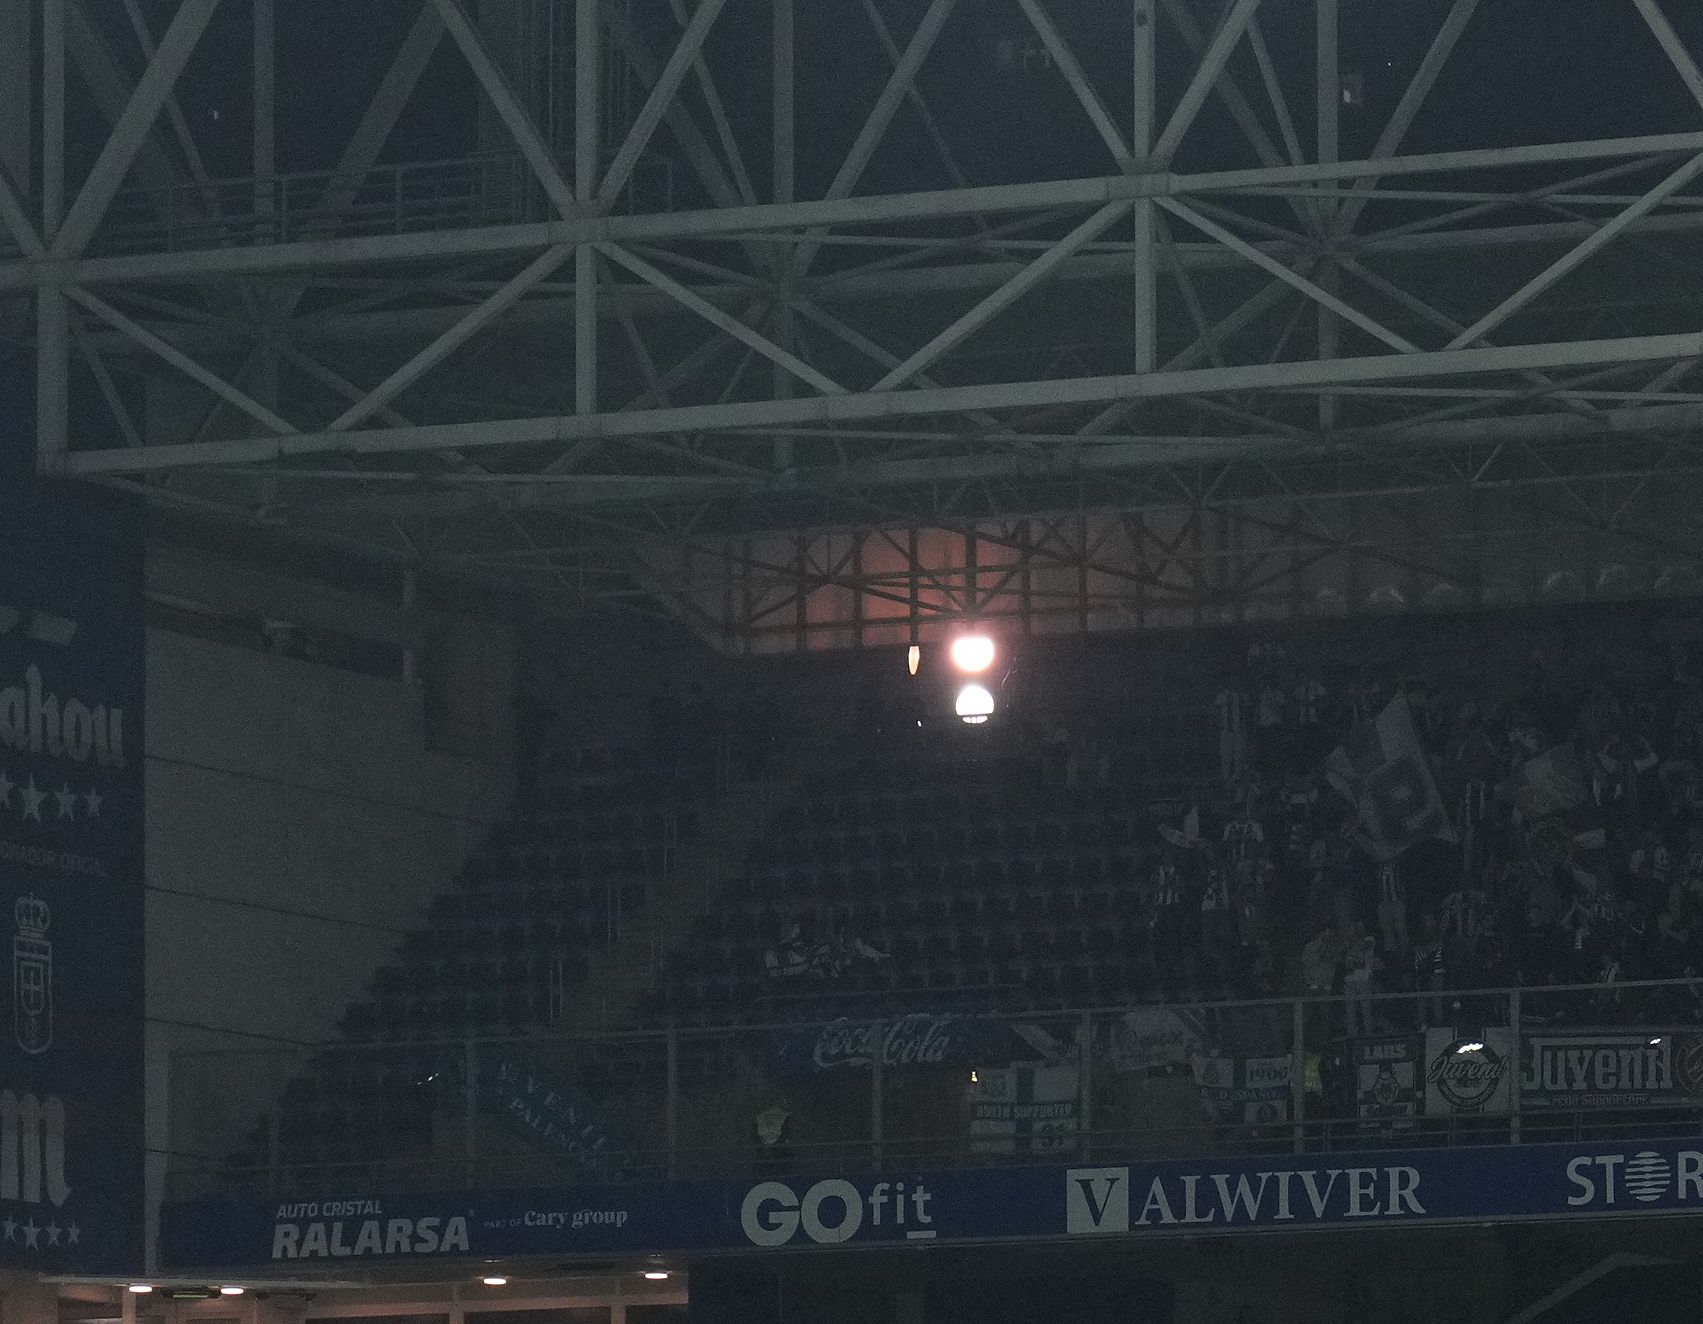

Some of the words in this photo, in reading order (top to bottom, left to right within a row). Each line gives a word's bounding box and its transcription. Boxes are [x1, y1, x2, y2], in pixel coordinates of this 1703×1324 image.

[276, 1202, 319, 1219] AUTO
[322, 1200, 383, 1217] CRISTAL
[1134, 1165, 1427, 1227] ALWIVER
[524, 1209, 568, 1230] Cary
[571, 1208, 629, 1230] group
[271, 1215, 470, 1259] RALARSA
